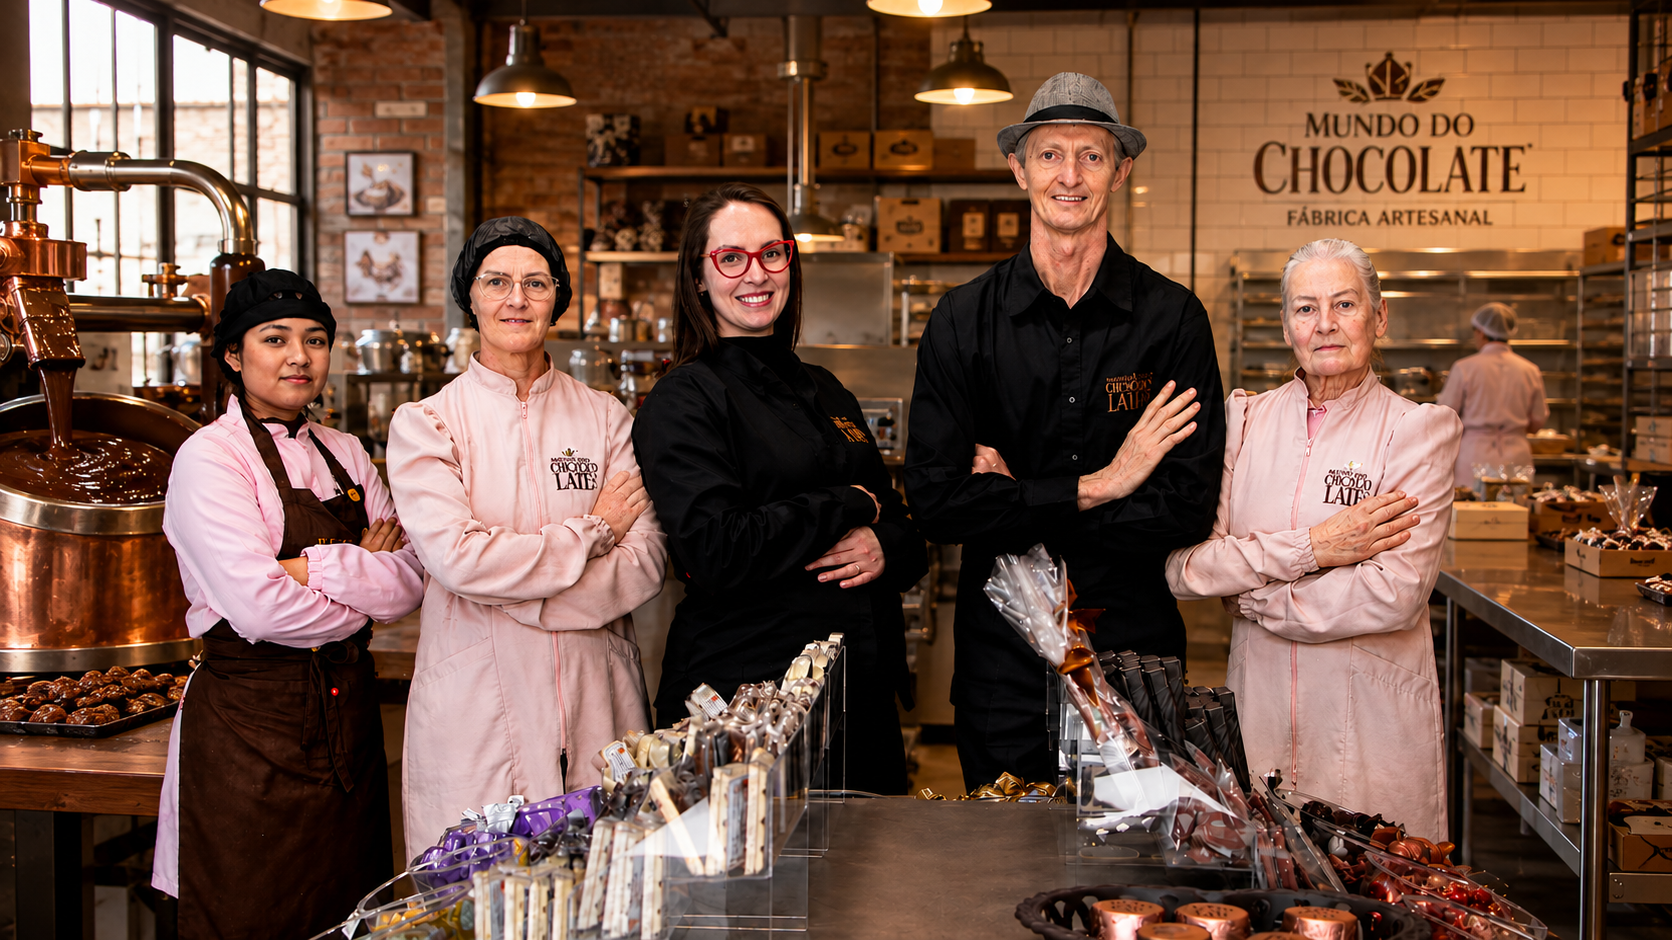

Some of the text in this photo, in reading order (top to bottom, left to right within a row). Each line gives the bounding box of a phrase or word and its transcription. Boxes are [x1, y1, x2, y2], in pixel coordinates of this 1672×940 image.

[1304, 112, 1474, 138] MUNDO DO
[1253, 140, 1527, 194] CHOCOLATE
[1287, 205, 1493, 227] FÁBRICA ARTESANAL
